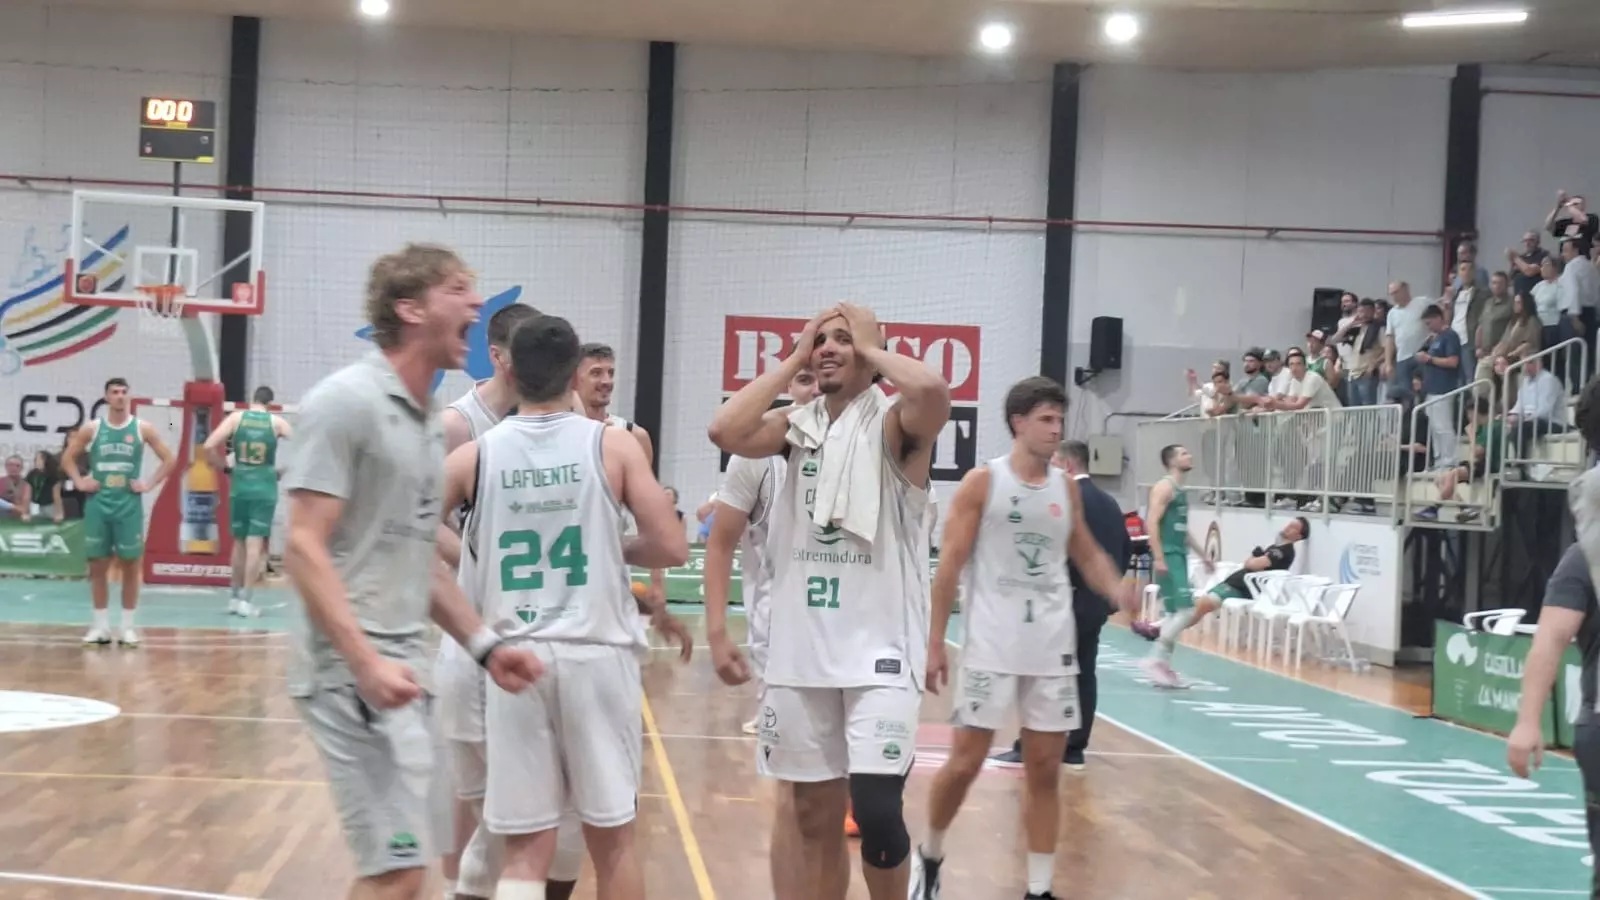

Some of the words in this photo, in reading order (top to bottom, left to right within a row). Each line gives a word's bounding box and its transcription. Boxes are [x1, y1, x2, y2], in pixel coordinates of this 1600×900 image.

[501, 463, 581, 489] LAFUENTE
[498, 525, 588, 591] 24
[807, 576, 840, 608] 21
[1023, 599, 1034, 623] 1
[1329, 758, 1595, 867] TOLED
